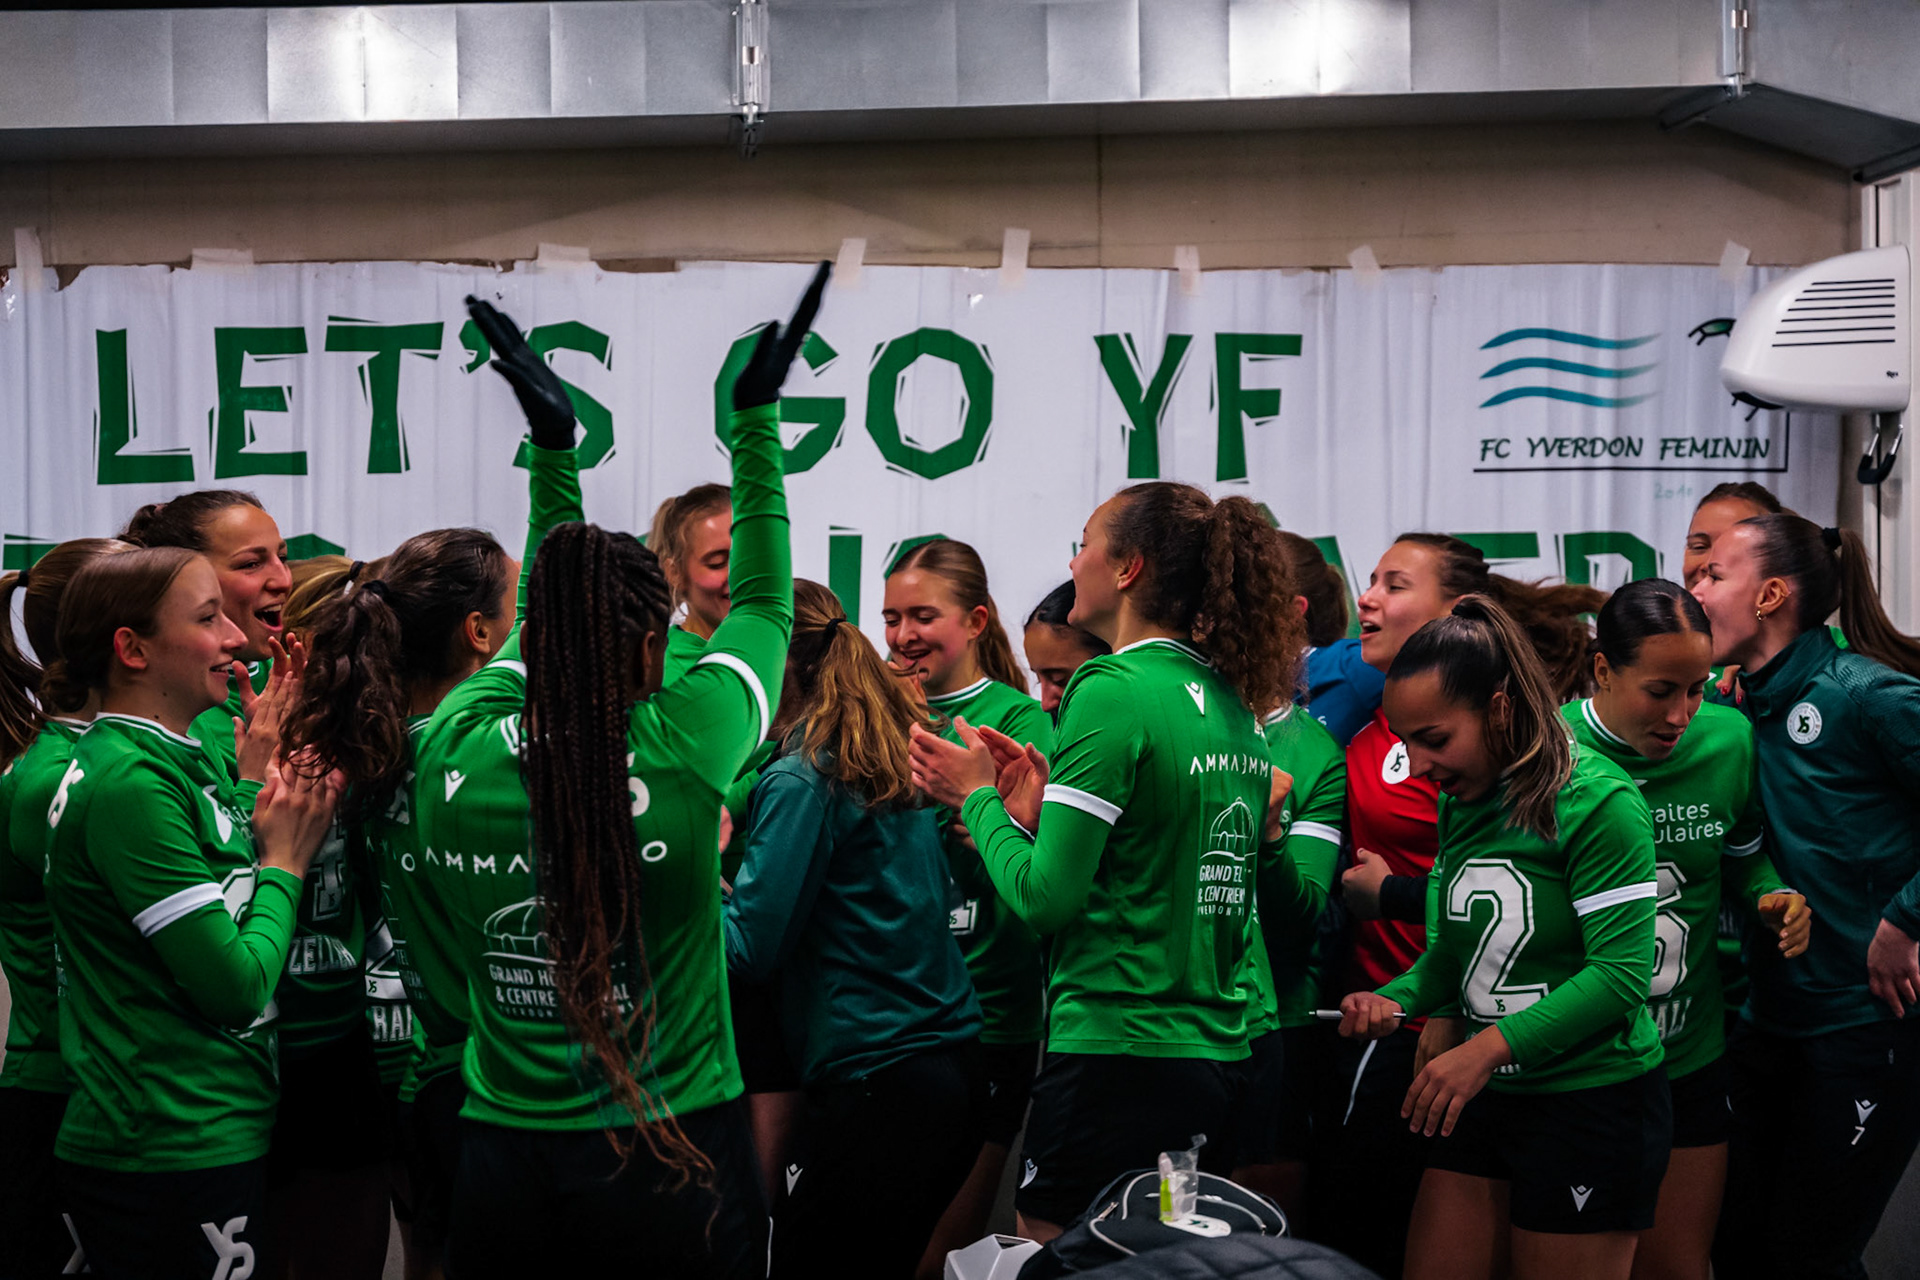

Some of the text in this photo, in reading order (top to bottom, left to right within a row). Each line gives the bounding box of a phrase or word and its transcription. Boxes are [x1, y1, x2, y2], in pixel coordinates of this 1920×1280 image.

[93, 315, 1303, 485] LET'S GO YF
[1480, 436, 1771, 462] FC YVERDON FEMININ
[1199, 864, 1232, 882] GRAND
[1446, 857, 1550, 1024] 2
[488, 963, 534, 986] GRAND
[506, 987, 558, 1008] CENTRE
[1850, 1125, 1866, 1146] 7
